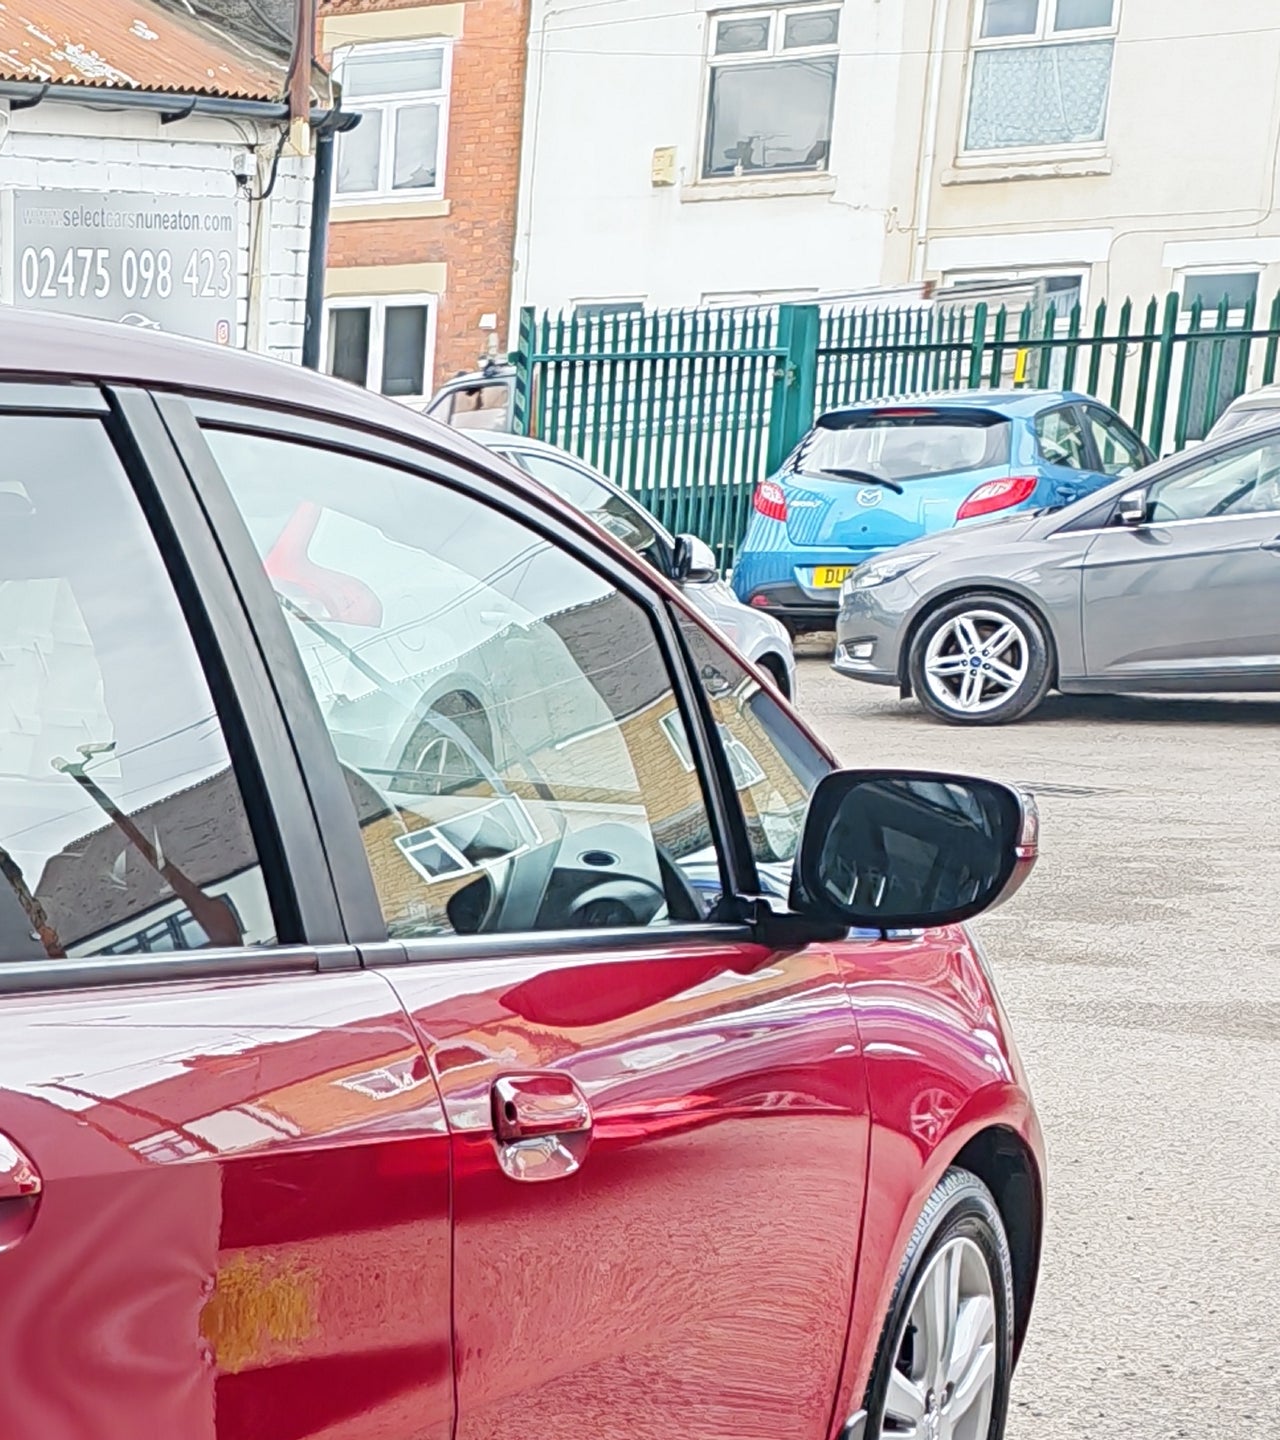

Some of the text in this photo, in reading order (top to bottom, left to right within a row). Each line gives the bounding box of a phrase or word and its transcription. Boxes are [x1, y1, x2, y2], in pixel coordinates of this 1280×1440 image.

[21, 246, 233, 299] 02475 098 423
